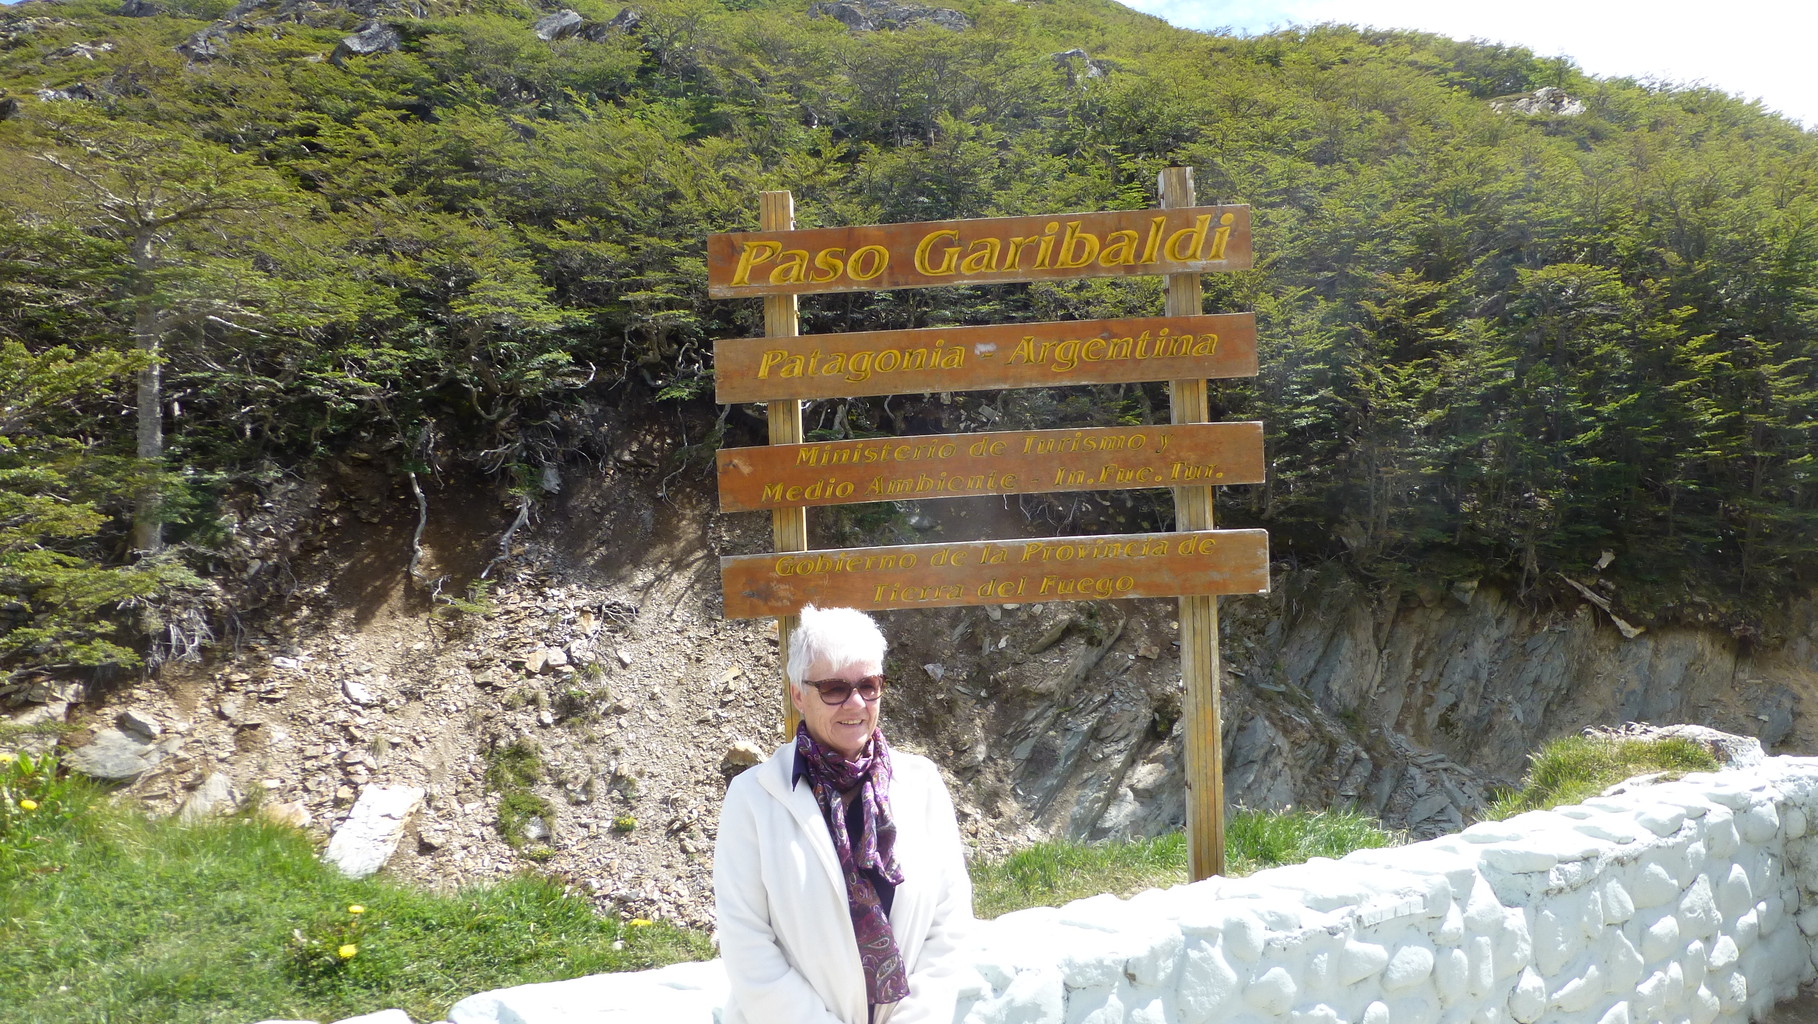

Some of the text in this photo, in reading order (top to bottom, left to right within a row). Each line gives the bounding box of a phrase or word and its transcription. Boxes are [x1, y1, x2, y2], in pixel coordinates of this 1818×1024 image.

[730, 212, 1234, 287] Paso Garibaldi
[757, 339, 965, 383] Patagonia
[1006, 327, 1219, 373] Argentina
[796, 432, 1175, 467] Ministerio de Turismo y
[761, 477, 854, 503] Medio
[864, 470, 1018, 497] Ambiente
[775, 534, 1217, 576] Gobierno de la Provincia de
[872, 574, 1135, 604] Tierra del Fuego
